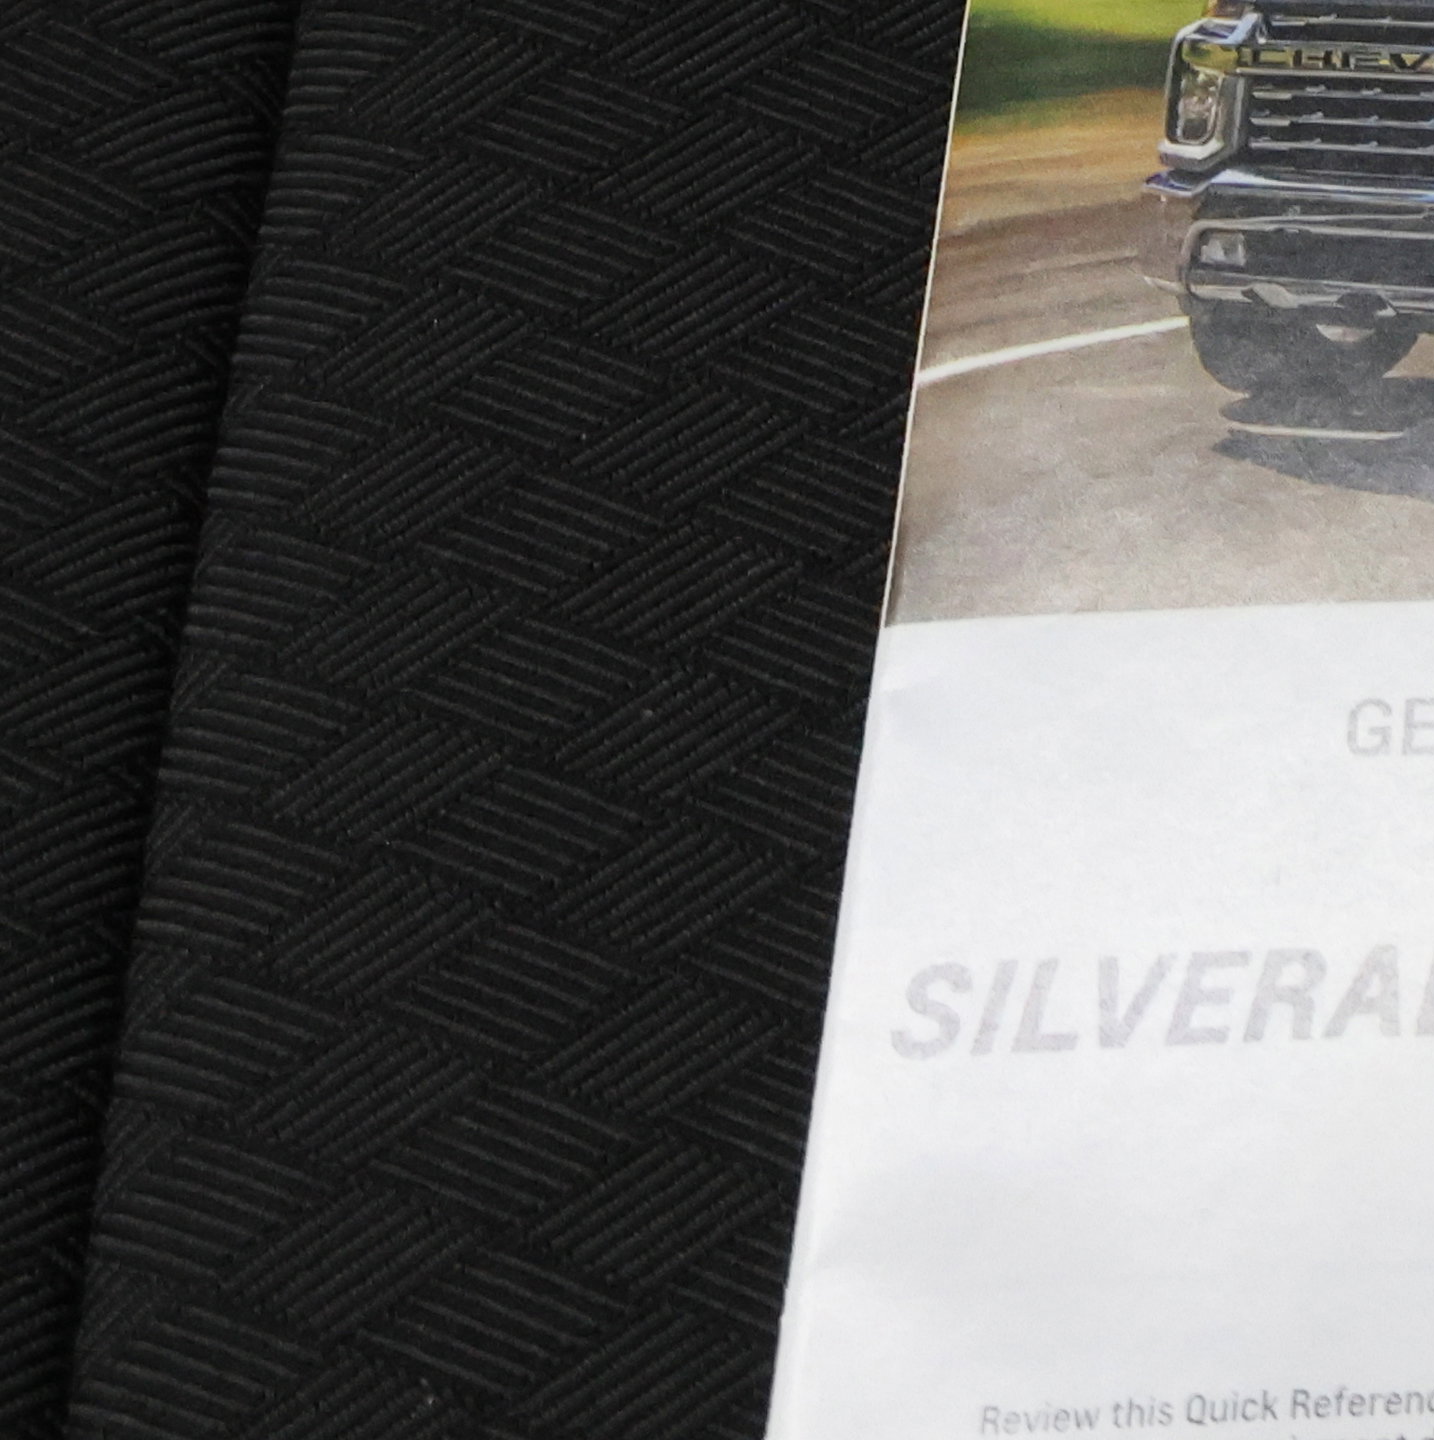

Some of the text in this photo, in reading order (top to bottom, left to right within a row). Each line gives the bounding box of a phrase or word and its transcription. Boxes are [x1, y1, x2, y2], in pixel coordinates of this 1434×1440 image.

[980, 1405, 1100, 1435] Review
[1111, 1398, 1174, 1429] this
[1185, 1389, 1278, 1427] Quick
